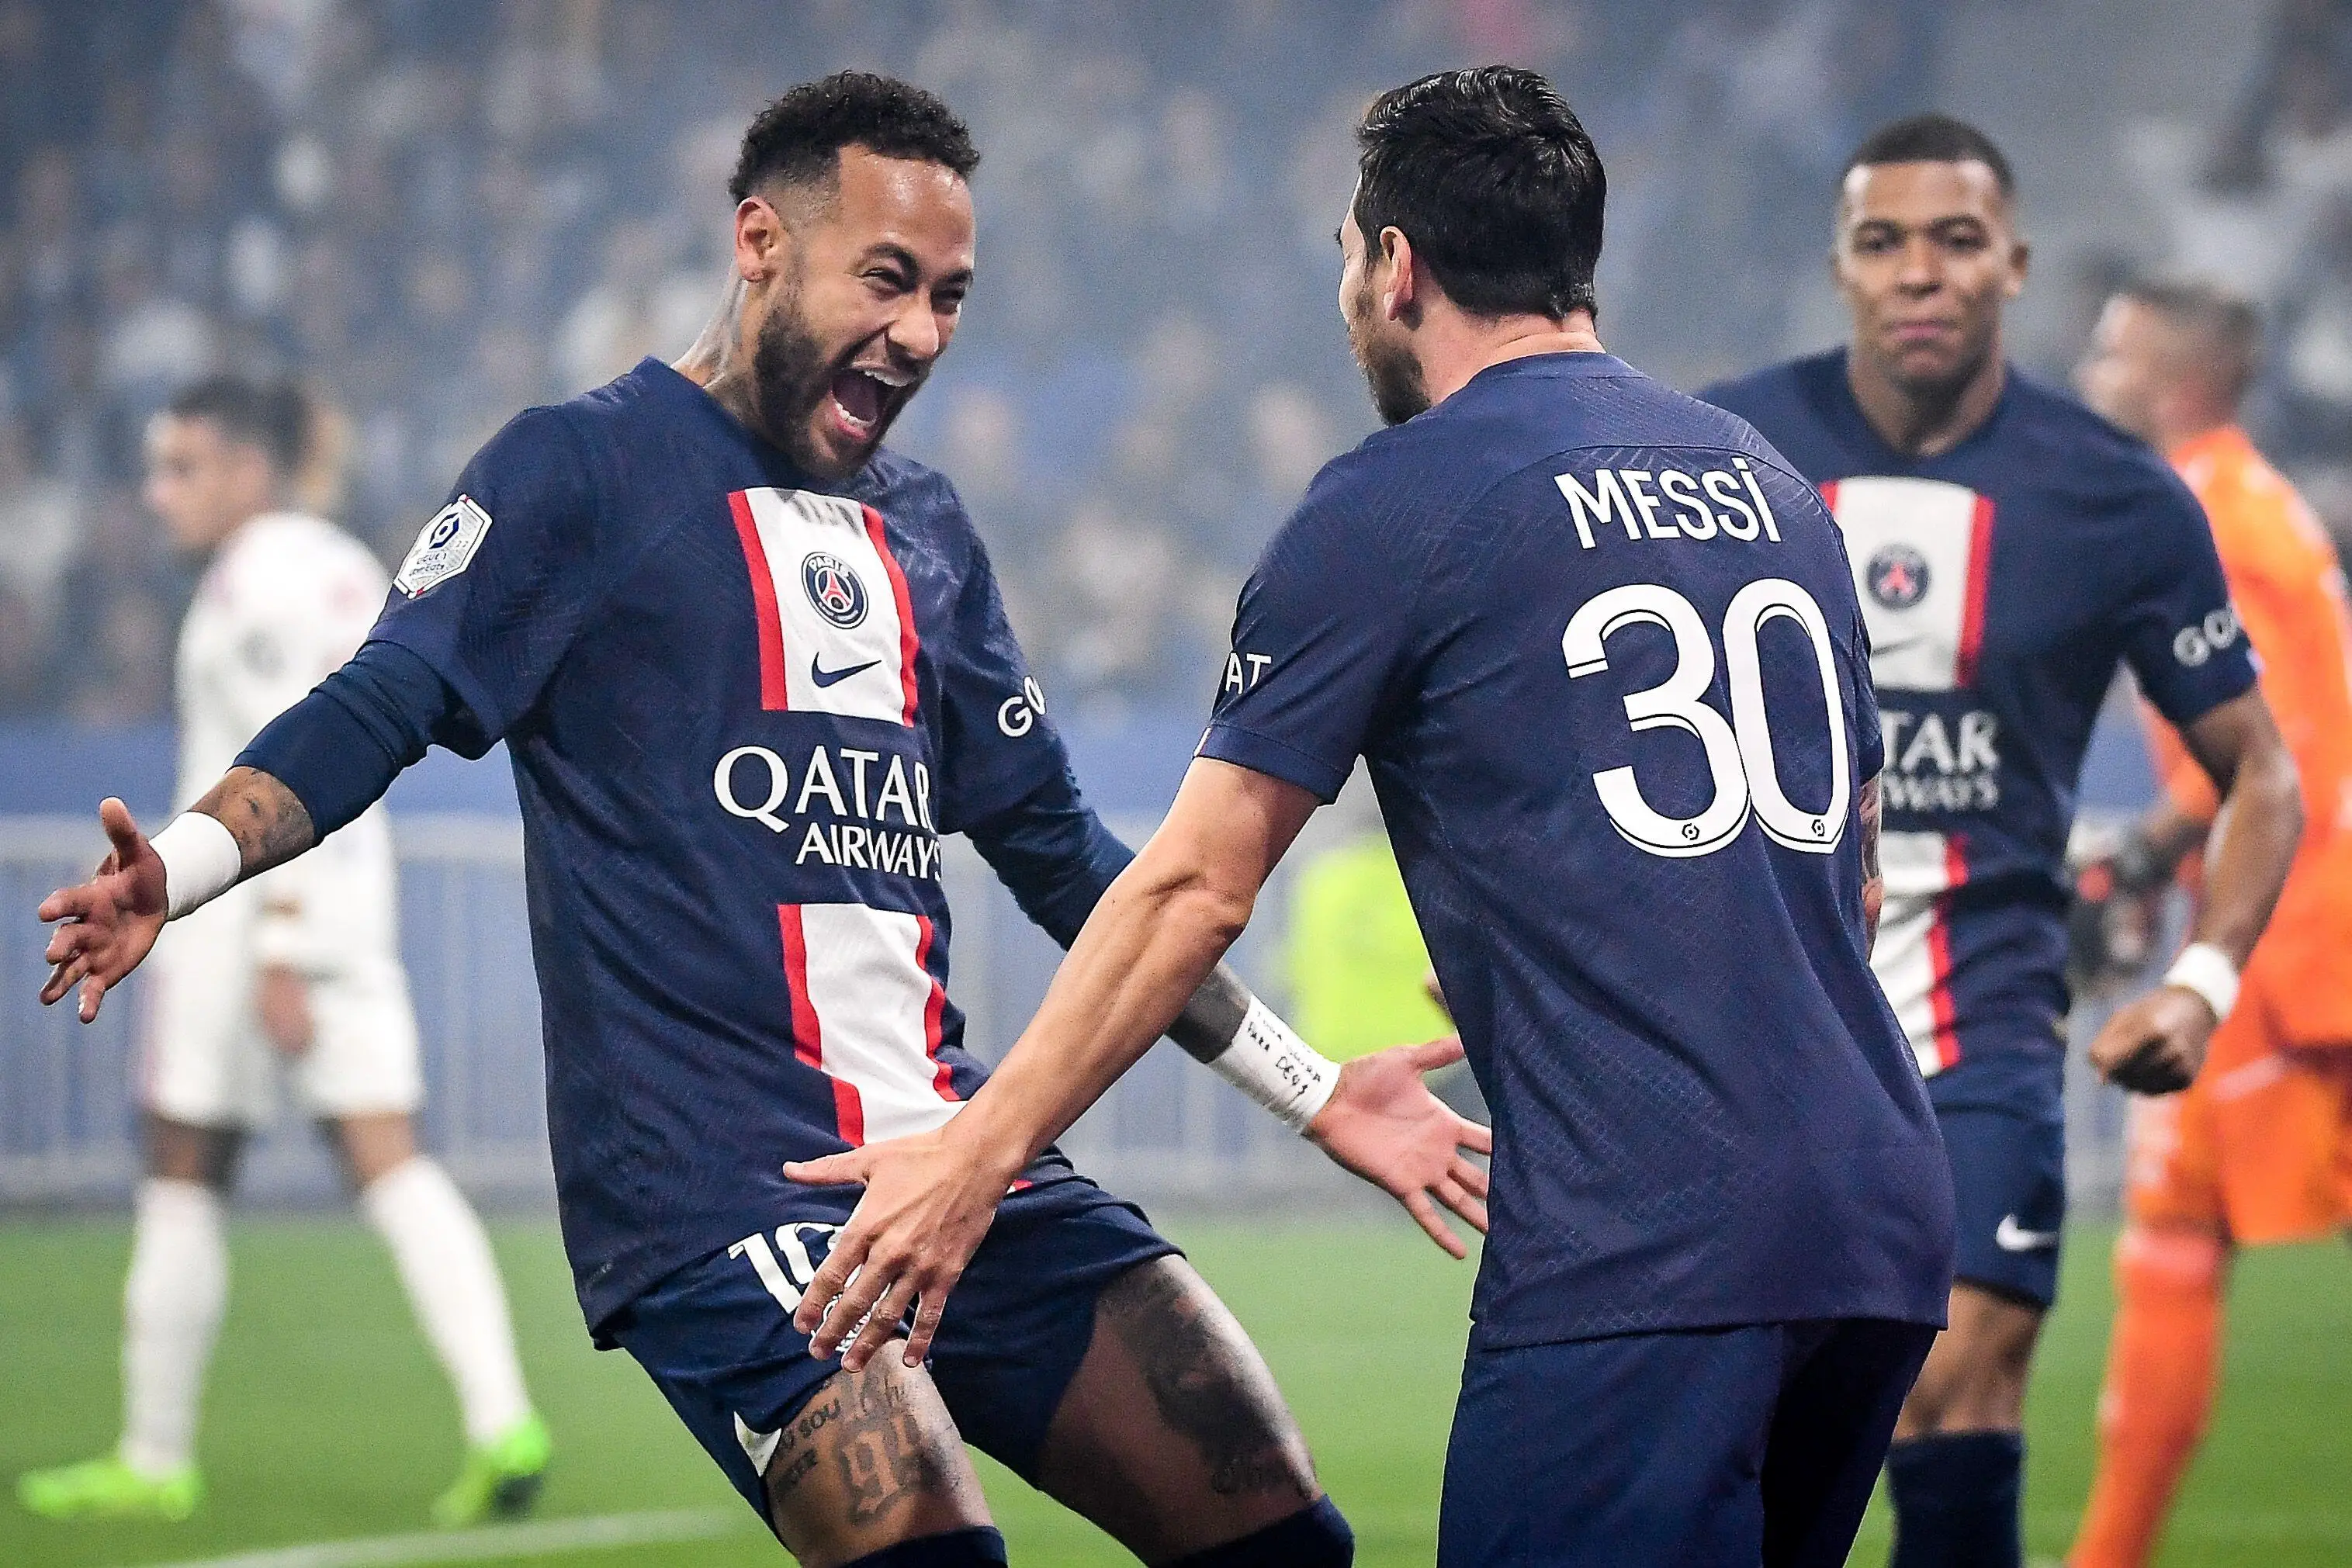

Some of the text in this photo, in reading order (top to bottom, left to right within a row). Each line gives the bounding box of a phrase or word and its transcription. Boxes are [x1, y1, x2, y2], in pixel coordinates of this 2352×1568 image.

[2174, 605, 2241, 666] GO
[1225, 652, 1272, 694] AT
[998, 676, 1046, 737] GO
[1562, 578, 1851, 857] 30
[714, 746, 936, 833] QATAR
